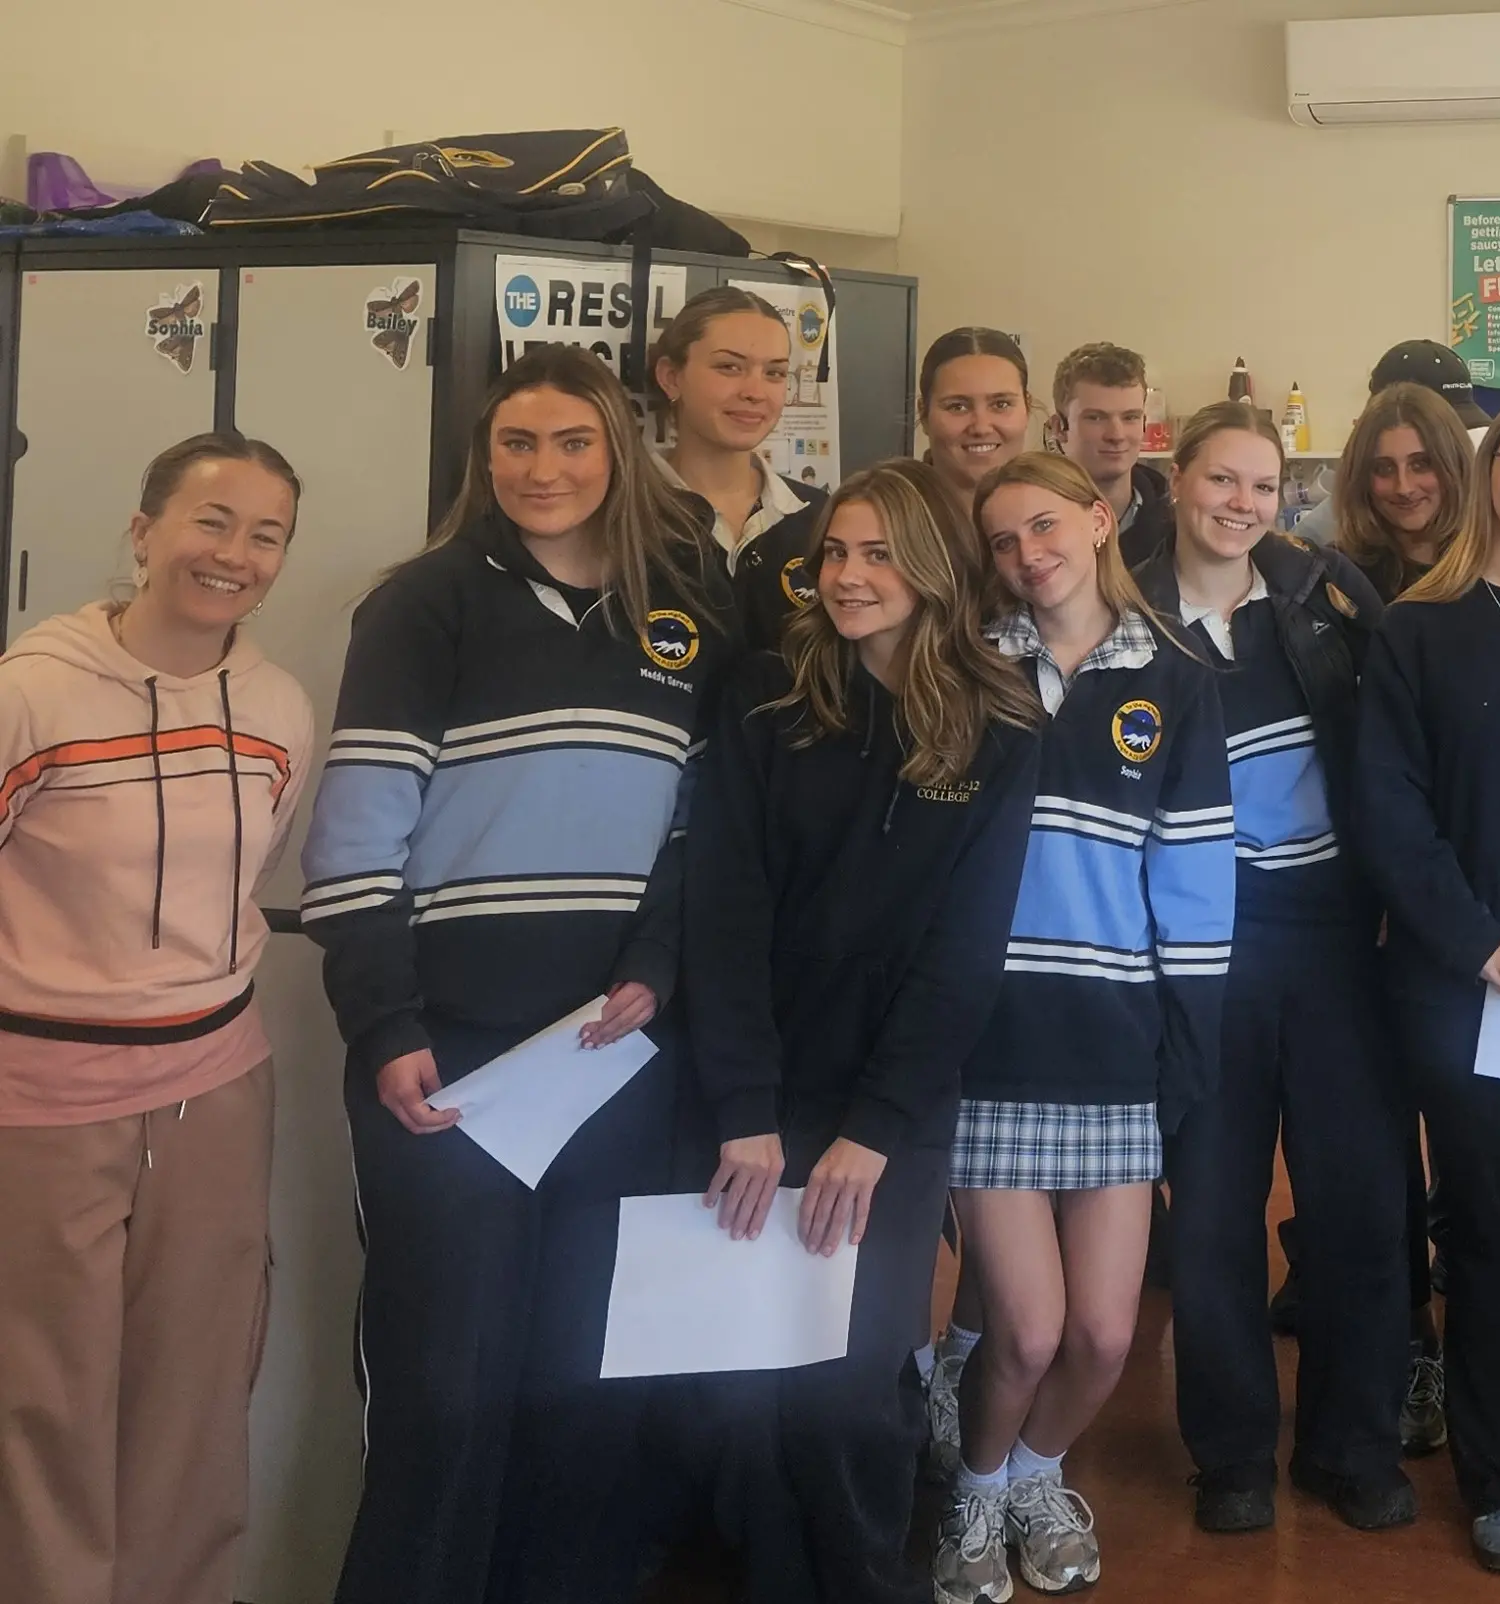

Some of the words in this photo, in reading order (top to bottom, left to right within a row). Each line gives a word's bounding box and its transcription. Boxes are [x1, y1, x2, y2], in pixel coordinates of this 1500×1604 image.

[1463, 214, 1500, 226] Before
[506, 291, 537, 311] THE
[547, 280, 674, 329] RESL
[147, 319, 203, 337] Sophia
[367, 311, 418, 336] Bailey
[916, 787, 970, 803] COLLEGE
